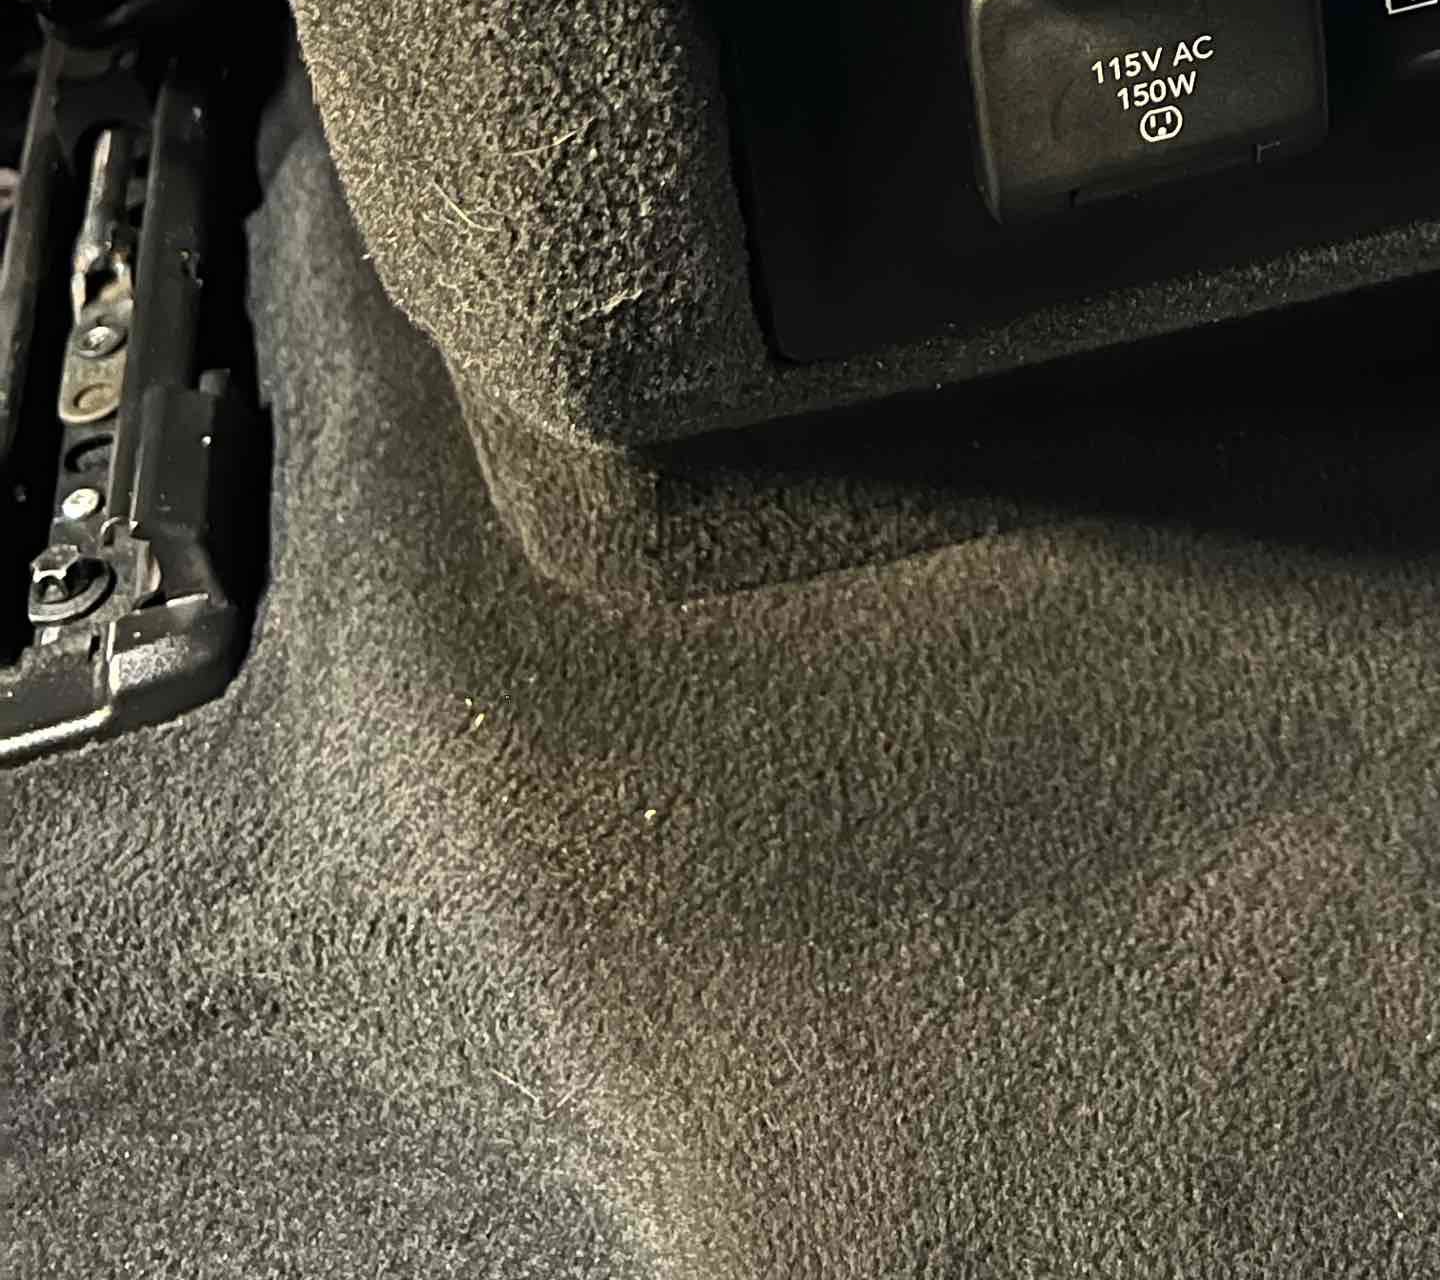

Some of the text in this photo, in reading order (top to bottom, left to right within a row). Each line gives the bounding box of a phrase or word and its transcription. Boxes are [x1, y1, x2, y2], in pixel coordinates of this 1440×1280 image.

[1091, 35, 1214, 84] 115V AC
[1117, 70, 1197, 110] 150W
